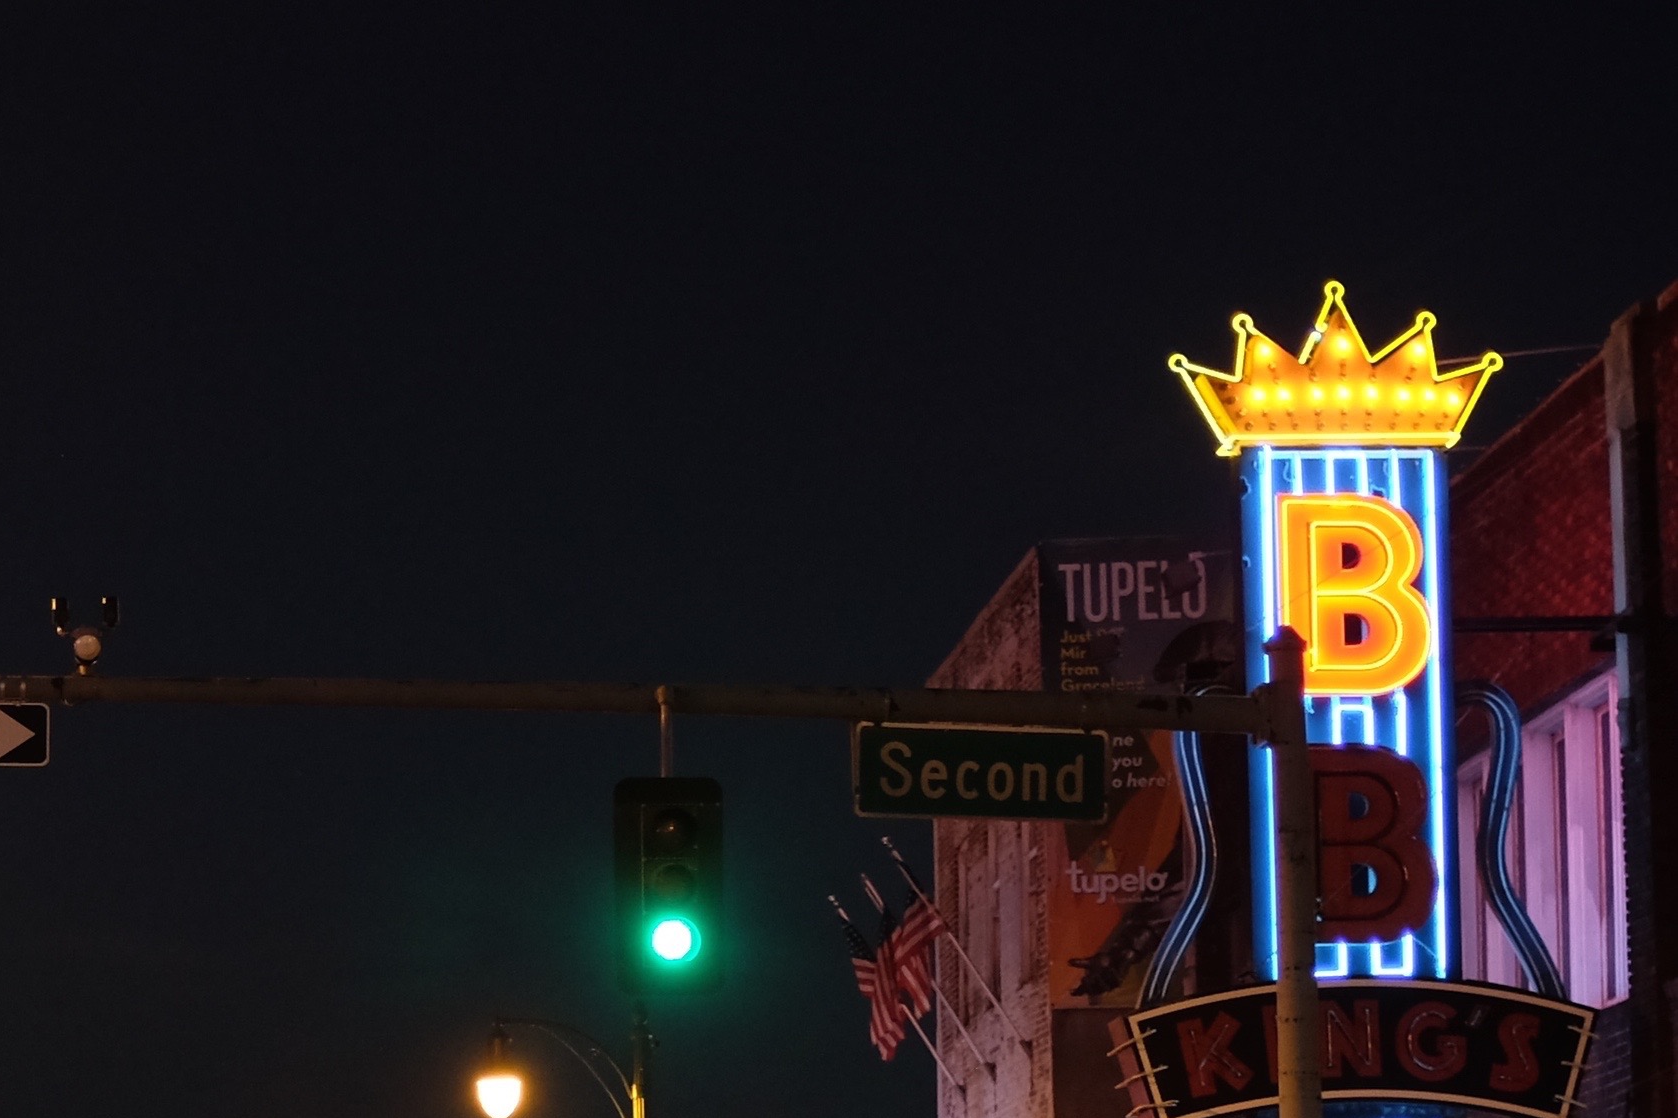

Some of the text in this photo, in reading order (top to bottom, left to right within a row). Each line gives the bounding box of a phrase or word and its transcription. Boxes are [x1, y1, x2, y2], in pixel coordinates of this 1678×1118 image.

[1277, 494, 1432, 696] B
[1061, 629, 1090, 644] Just
[1061, 662, 1099, 676] from
[879, 741, 1085, 803] Second
[1067, 861, 1169, 904] tupelo
[1176, 998, 1542, 1098] KING'S
